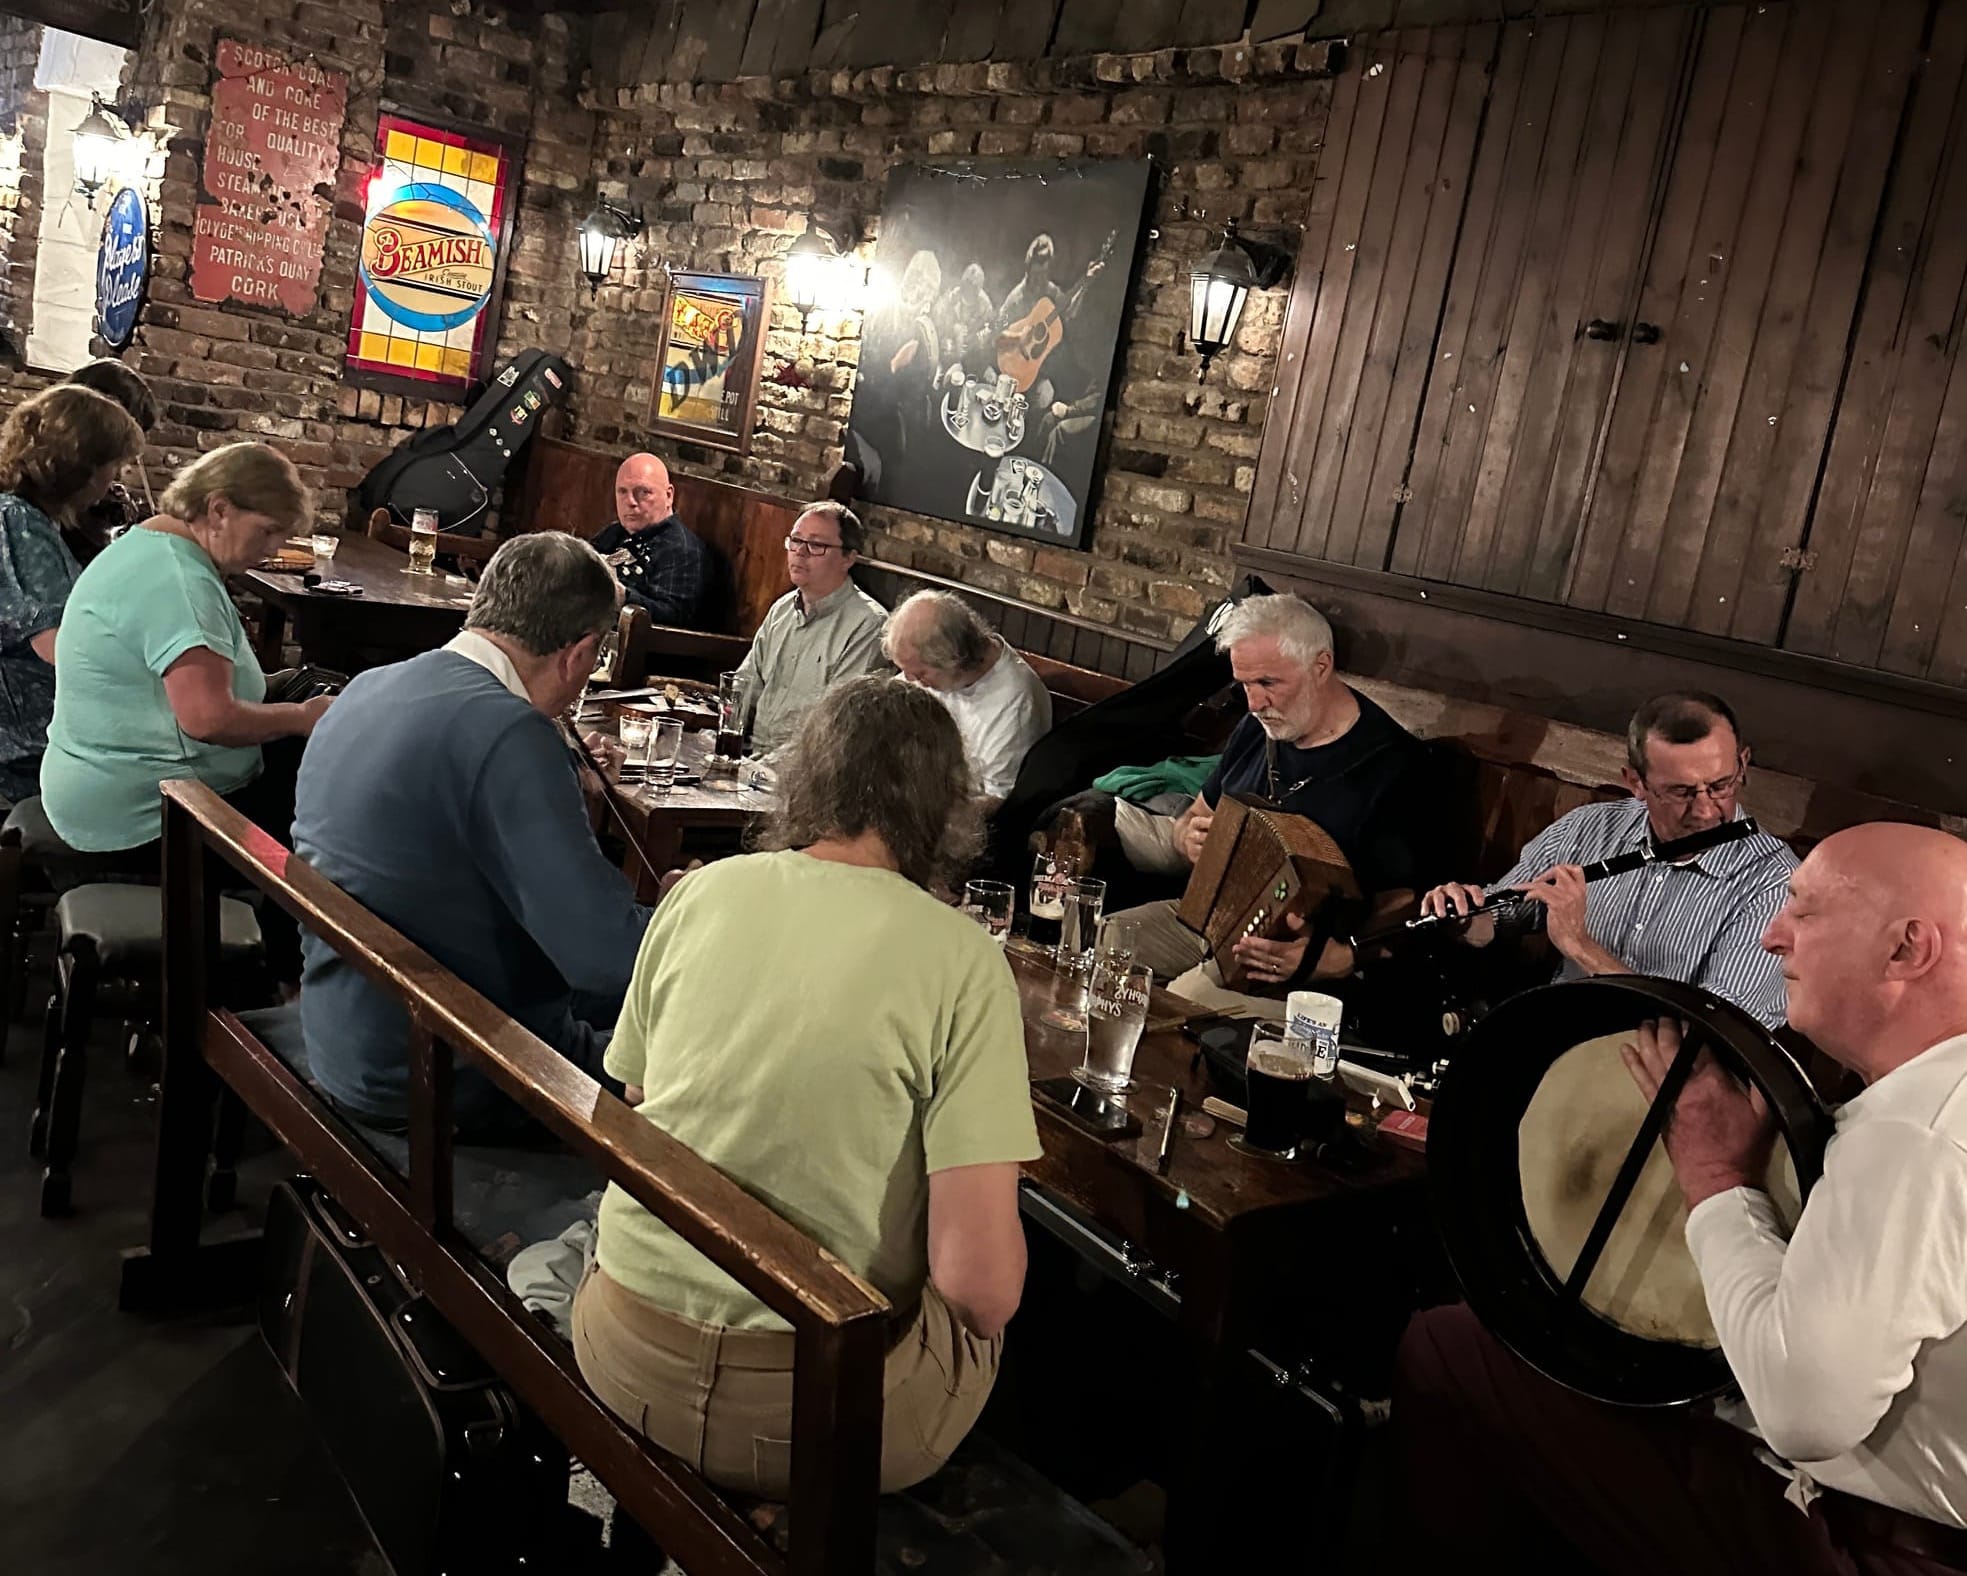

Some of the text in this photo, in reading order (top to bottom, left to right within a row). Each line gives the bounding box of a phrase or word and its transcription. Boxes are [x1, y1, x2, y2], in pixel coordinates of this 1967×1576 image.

[233, 46, 335, 88] SCOTCH COAL
[246, 76, 321, 110] AND COKE
[252, 103, 338, 138] OF THE BEST
[267, 133, 326, 161] QUALITY
[199, 218, 236, 241] CLYDE
[237, 225, 290, 253] HIPPING
[371, 228, 485, 277] BEAMISH
[232, 275, 279, 300] CORK
[279, 261, 311, 281] QUAY
[424, 273, 452, 286] IRISH
[456, 280, 483, 293] STOUT
